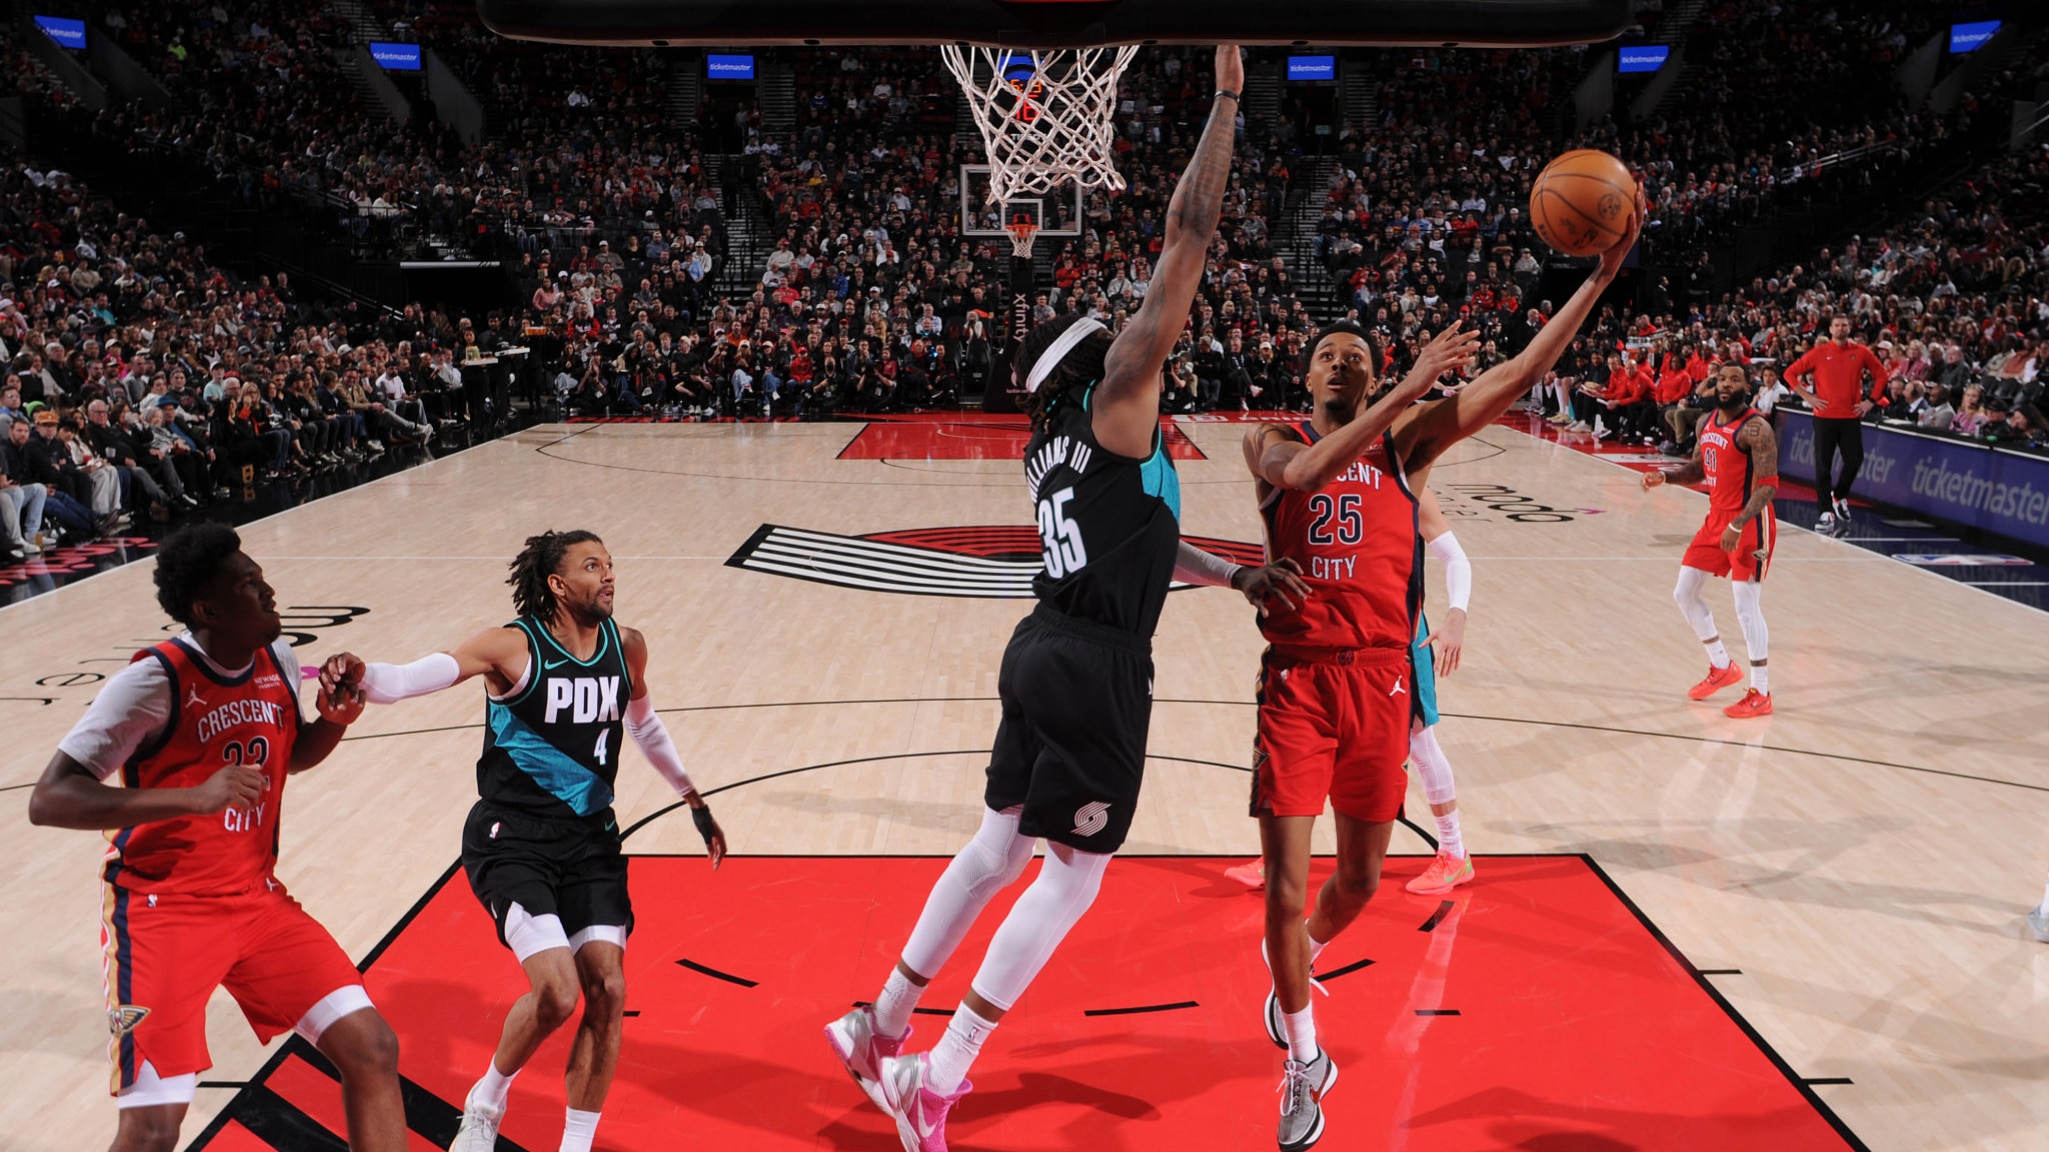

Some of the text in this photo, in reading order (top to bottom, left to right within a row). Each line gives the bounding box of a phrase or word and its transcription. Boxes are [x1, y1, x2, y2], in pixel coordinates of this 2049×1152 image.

[710, 63, 751, 71] ticketmaster
[1013, 293, 1030, 342] xfinity
[1069, 440, 1092, 475] III
[1704, 447, 1717, 473] 41
[1038, 486, 1087, 579] 35
[1308, 494, 1363, 545] 25
[1312, 554, 1358, 581] CITY
[544, 675, 620, 724] PDX
[198, 699, 285, 744] CRESCENT
[593, 727, 610, 766] 4
